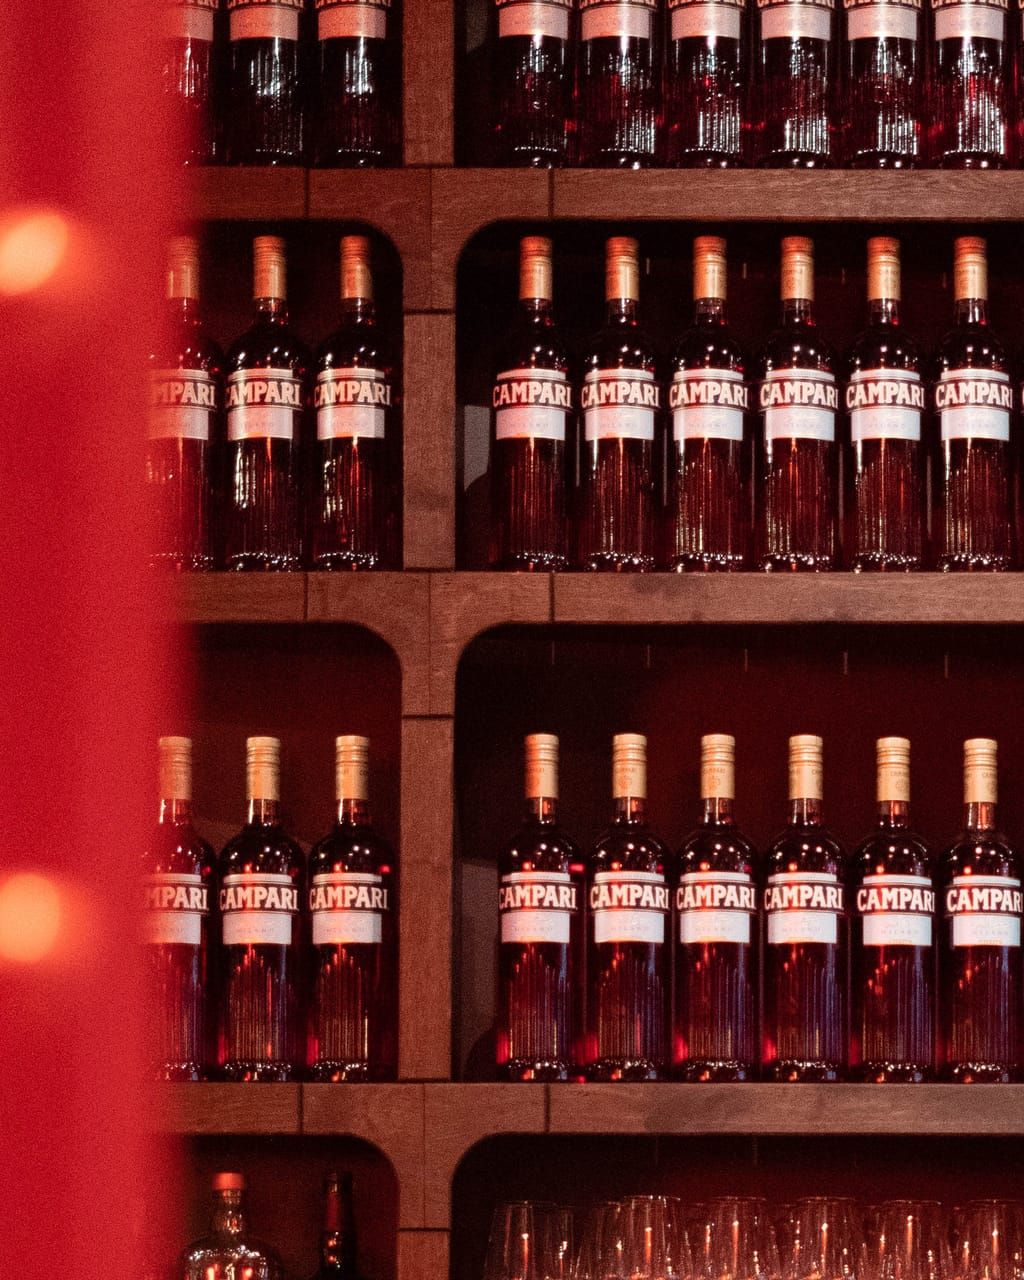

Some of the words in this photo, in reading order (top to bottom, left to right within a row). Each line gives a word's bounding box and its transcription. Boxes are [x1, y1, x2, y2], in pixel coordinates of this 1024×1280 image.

[151, 381, 216, 406] MPARI
[314, 381, 391, 407] CAMPARI
[493, 381, 572, 408] CAMPARI
[581, 381, 659, 408] CAMPARI
[669, 381, 748, 408] CAMPARI
[760, 381, 838, 408] CAMPARI
[846, 381, 924, 408] CAMPARI
[935, 381, 1013, 408] CAMPARI
[150, 886, 208, 910] MPARI
[219, 886, 298, 911] CAMPARI
[309, 886, 388, 911] CAMPARI
[500, 884, 577, 910] CAMPARI
[590, 884, 669, 910] CAMPARI
[677, 884, 756, 910] CAMPARI
[764, 884, 842, 910] CAMPARI
[857, 887, 935, 912] CAMPARI
[947, 887, 1023, 912] CAMPARI
